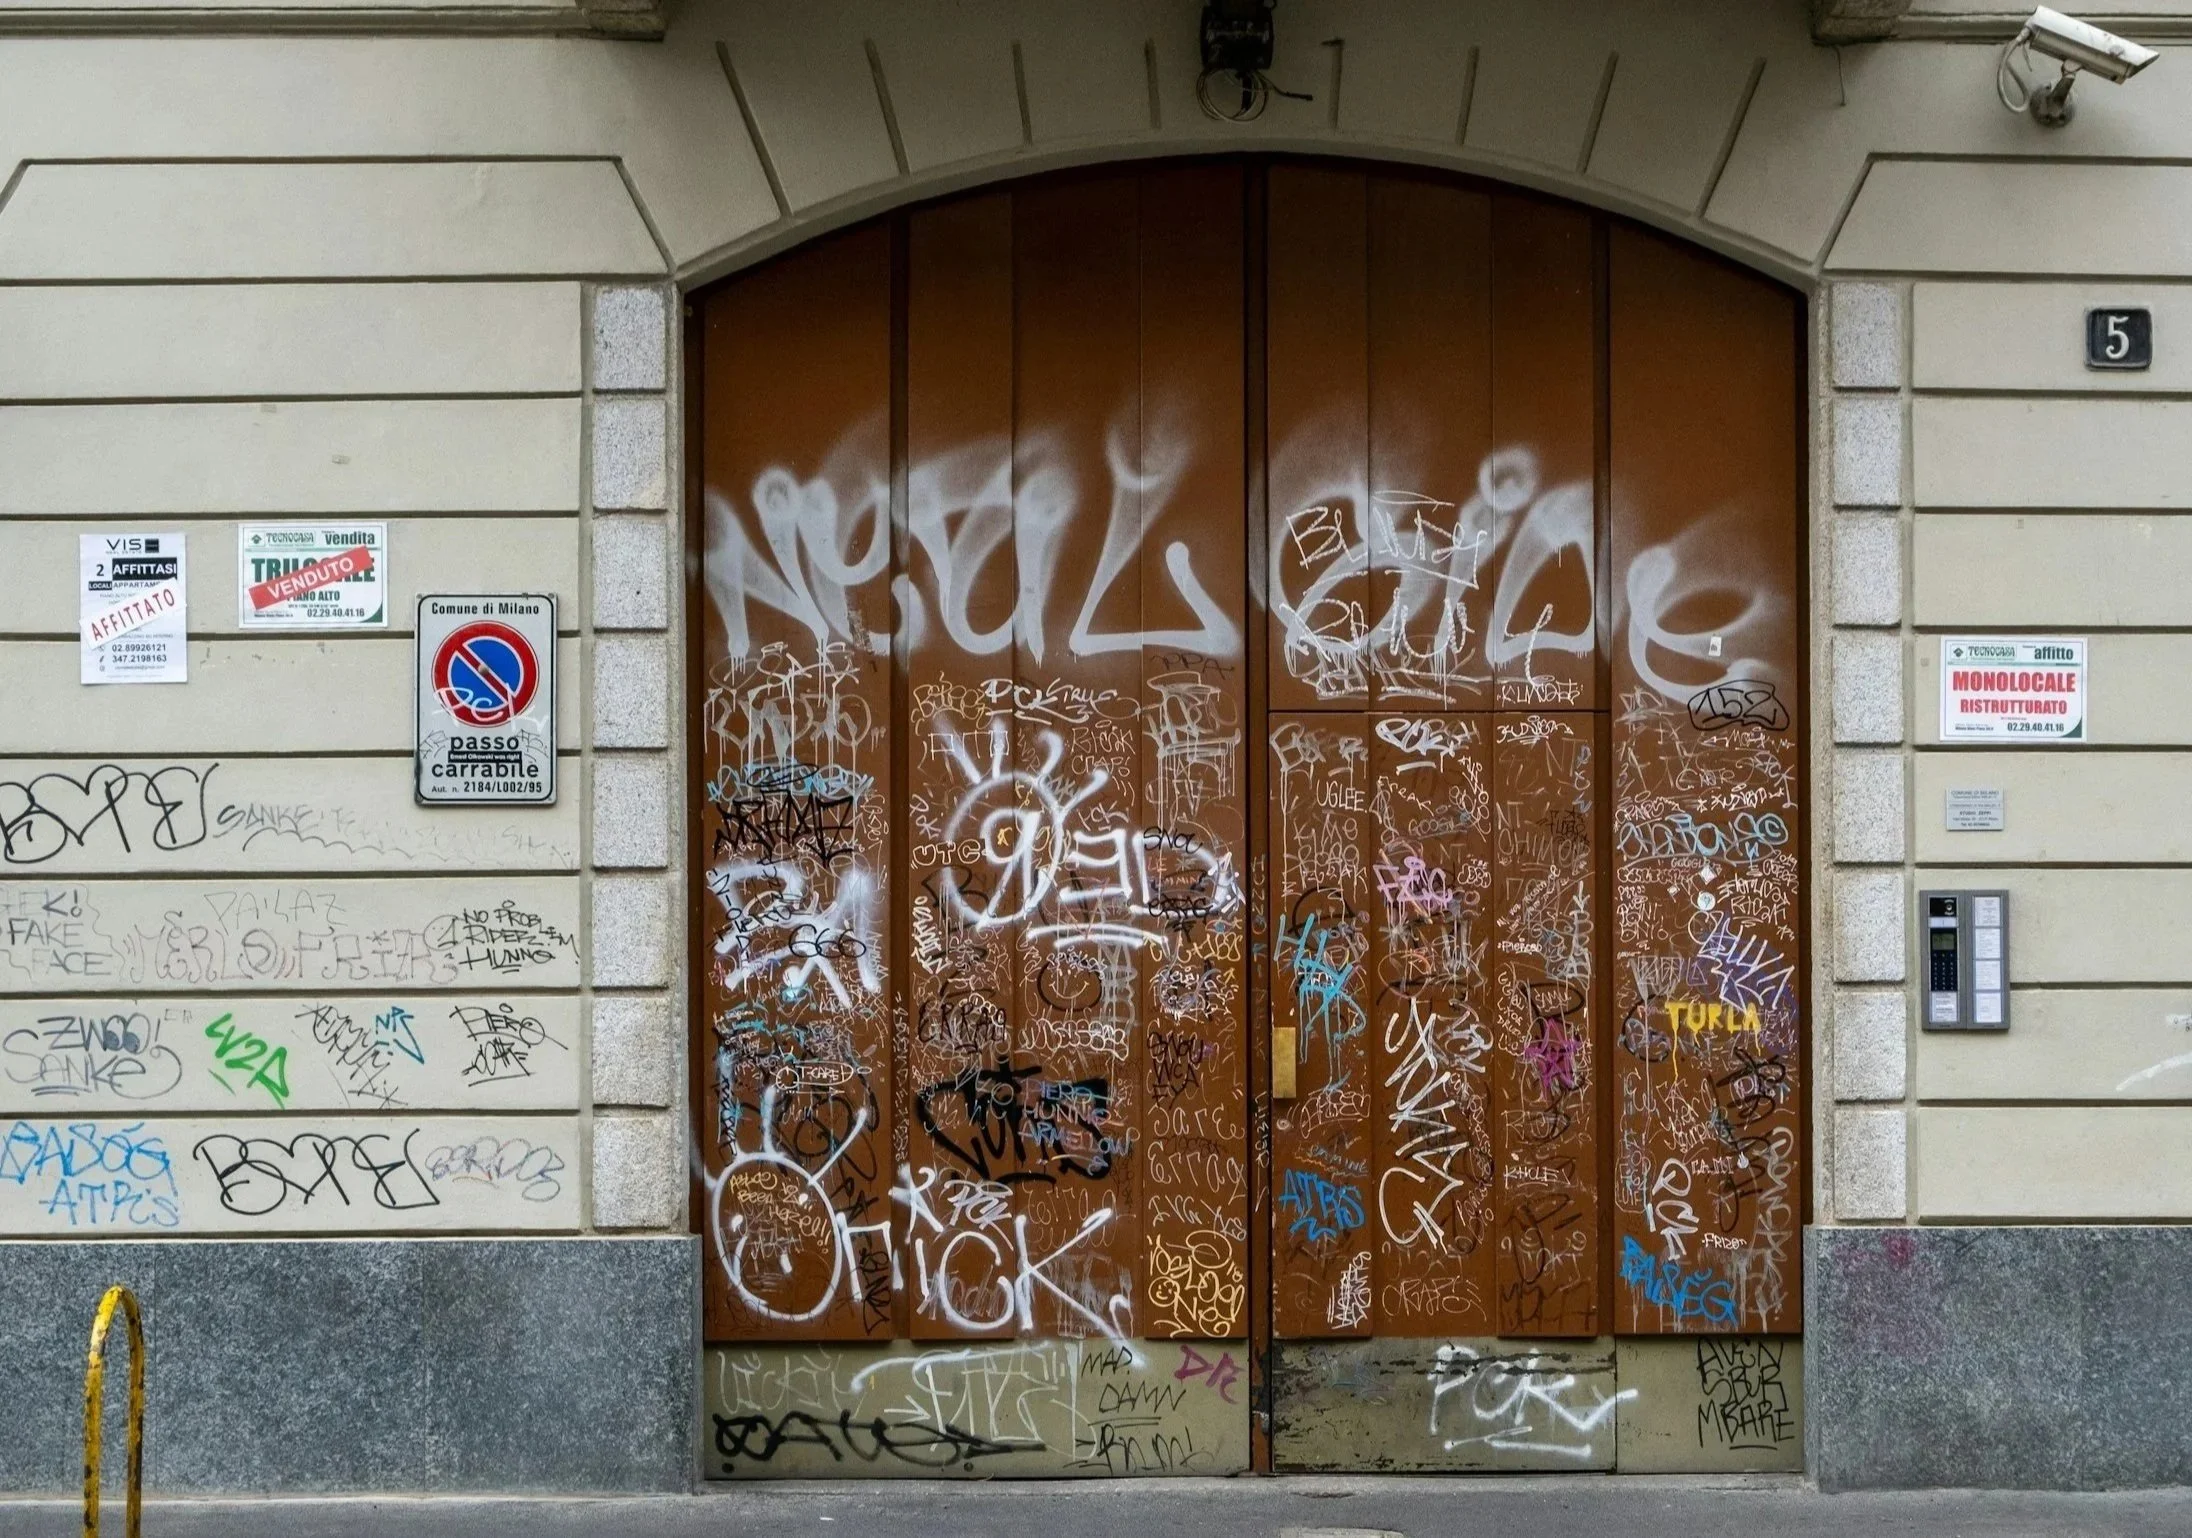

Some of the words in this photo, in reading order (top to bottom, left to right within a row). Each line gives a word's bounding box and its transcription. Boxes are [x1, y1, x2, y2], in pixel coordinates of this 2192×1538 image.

[2106, 315, 2130, 361] 5
[106, 538, 142, 550] VIS
[325, 531, 375, 545] vendita
[96, 563, 104, 577] 2
[113, 563, 177, 574] AFFITTASI
[267, 556, 354, 599] VENDUTO
[319, 590, 340, 601] ALTO
[91, 588, 175, 641] AFFITTATO
[431, 602, 478, 614] Comune
[482, 602, 494, 614] di
[498, 602, 540, 614] Milano
[112, 643, 166, 652] 02.89926121
[2034, 647, 2074, 660] affitto
[112, 654, 167, 663] 347.2198163
[1952, 670, 2076, 693] MONOLOCALE
[1960, 698, 2068, 715] RISTRUTTURATO
[450, 735, 520, 751] passo
[431, 762, 539, 778] carrabile
[463, 781, 542, 793] 2184/L002/95
[8, 918, 85, 949] FAKE
